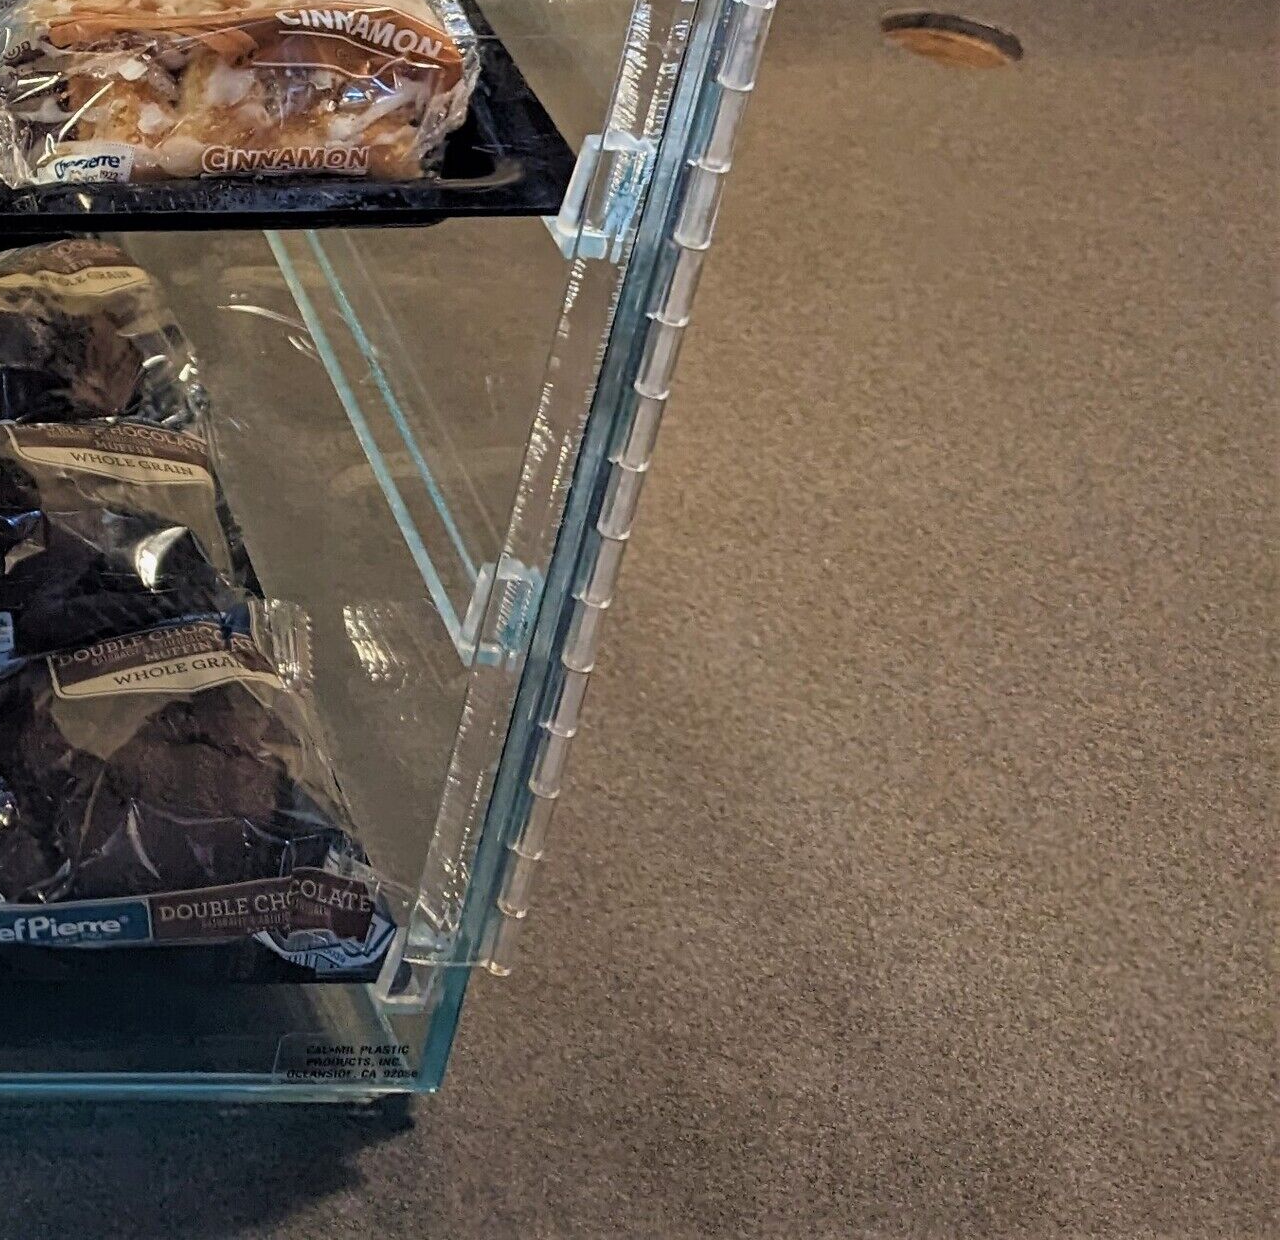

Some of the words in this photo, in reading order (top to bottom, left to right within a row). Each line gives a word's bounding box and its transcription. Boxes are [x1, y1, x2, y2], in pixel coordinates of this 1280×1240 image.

[275, 8, 445, 60] CINNAMON
[201, 144, 370, 175] CINNAMON
[69, 451, 136, 468] WHOLE
[139, 460, 193, 476] GRAIN
[113, 662, 188, 685] WHOLE
[159, 897, 249, 923] DOUBLE
[359, 1044, 409, 1055] PLASTIC
[361, 1069, 377, 1079] CA
